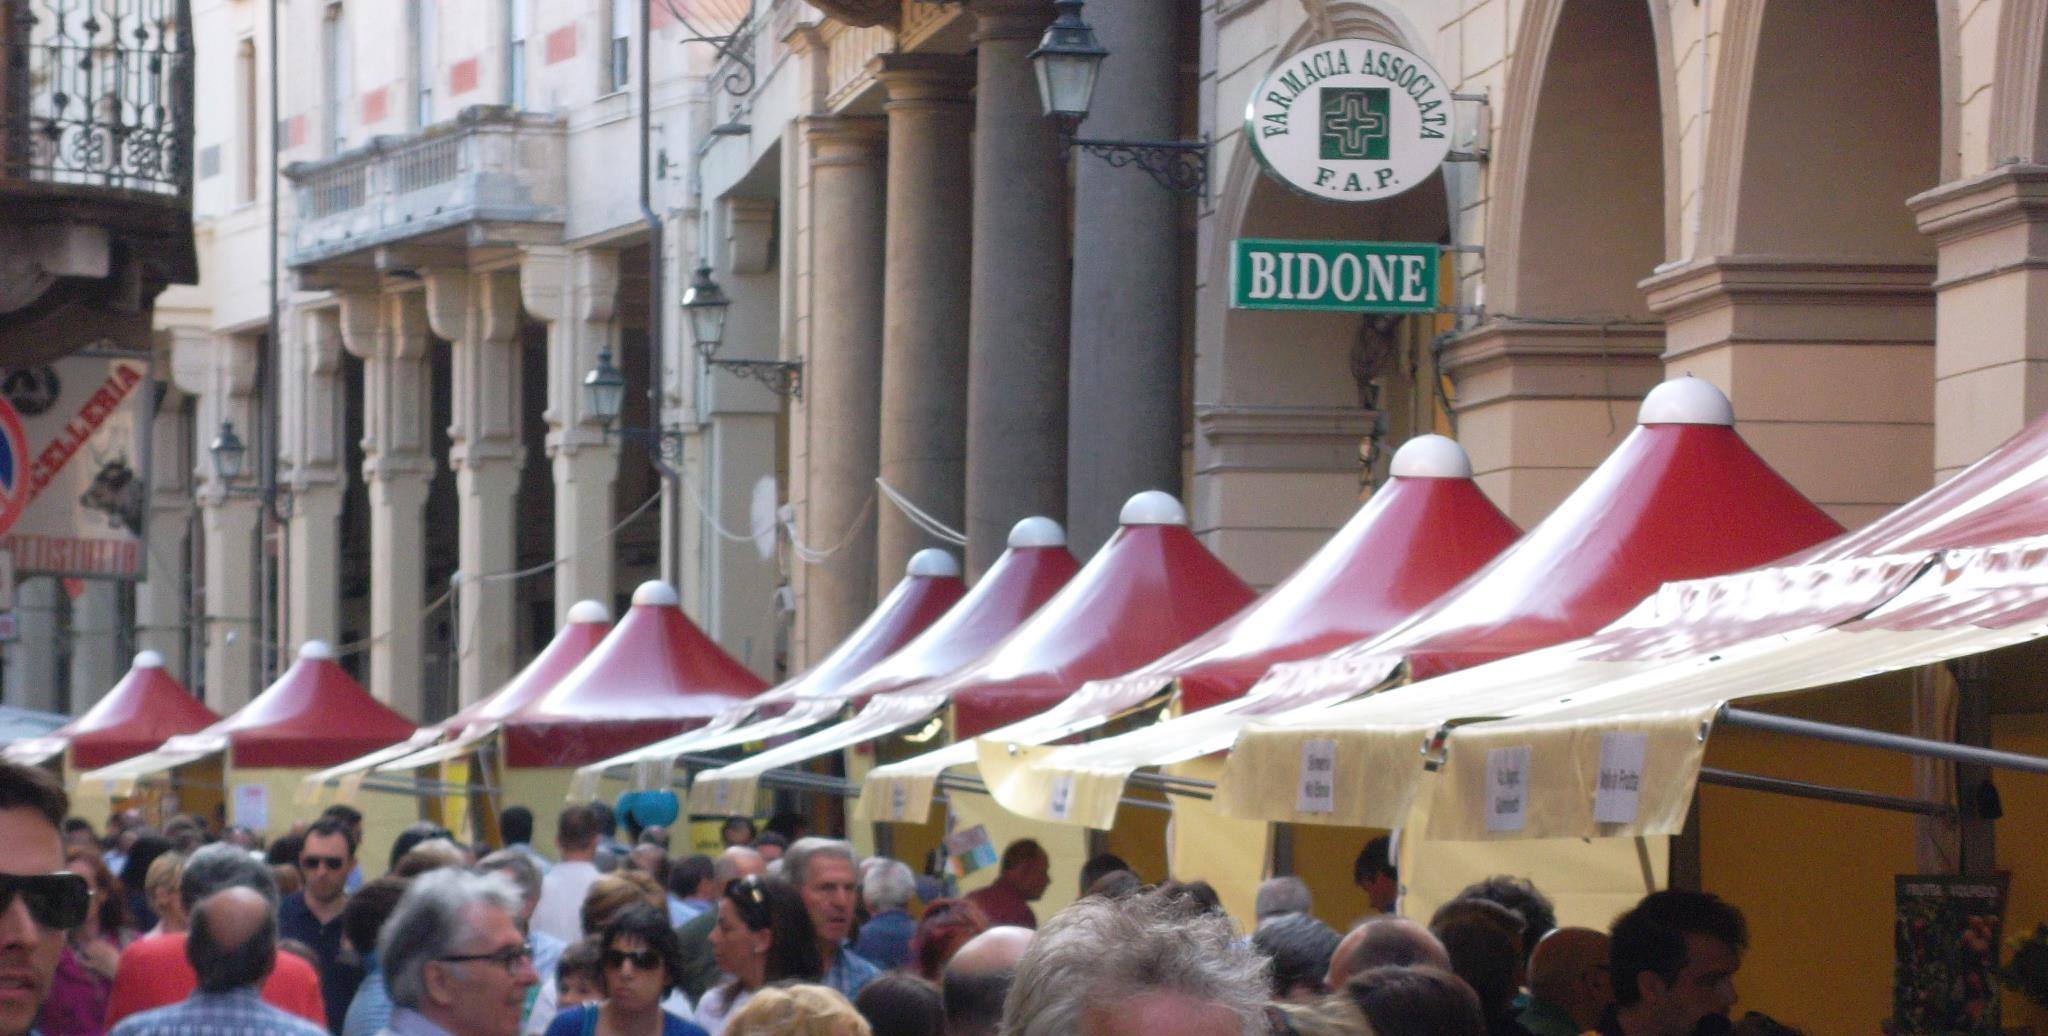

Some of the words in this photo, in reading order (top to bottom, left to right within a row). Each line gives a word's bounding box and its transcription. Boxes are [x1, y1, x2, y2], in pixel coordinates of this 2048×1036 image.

[1262, 48, 1351, 140] FARMACIA
[1361, 48, 1448, 140] ASSOCIATA
[1313, 166, 1400, 192] F.A.P.
[1248, 251, 1428, 302] BIDONE
[28, 362, 142, 500] CELLERIA
